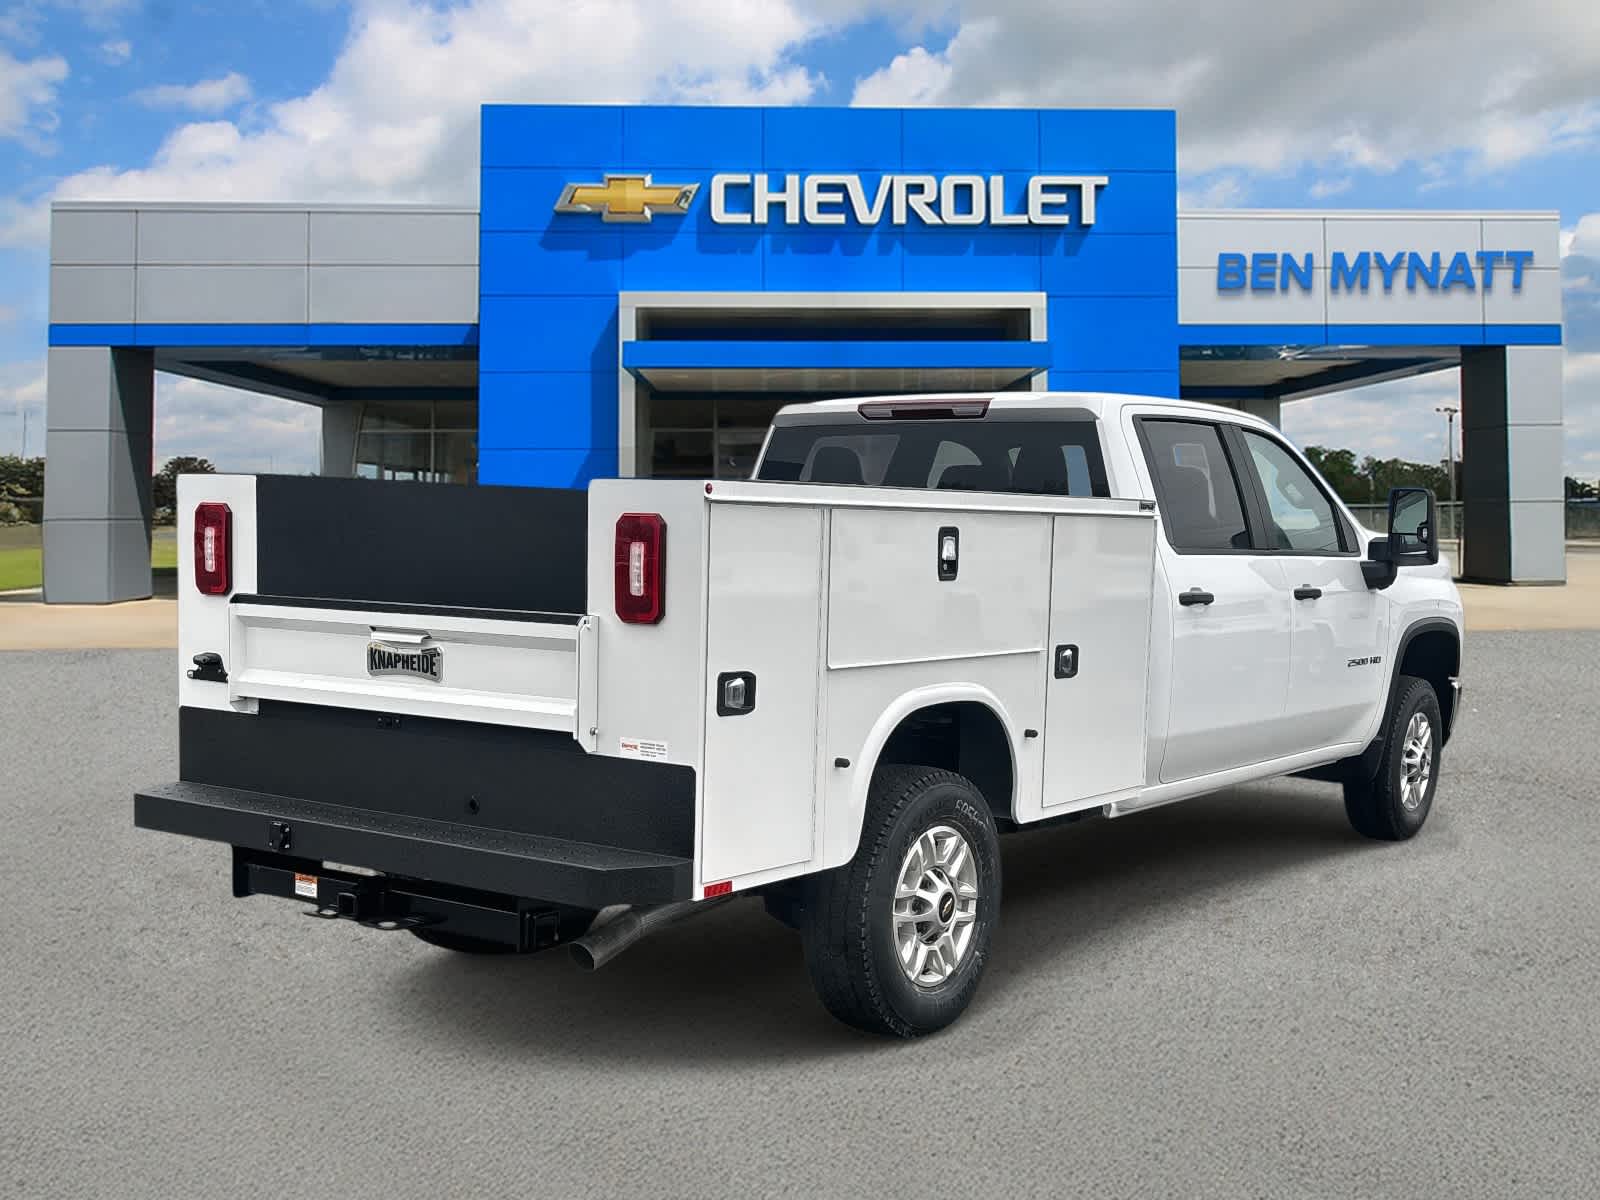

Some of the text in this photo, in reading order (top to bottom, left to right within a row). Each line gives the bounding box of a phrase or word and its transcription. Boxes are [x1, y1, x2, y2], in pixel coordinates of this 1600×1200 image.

[710, 173, 1109, 225] CHEVROLET
[1217, 250, 1534, 290] BEN MYNATT
[369, 646, 439, 677] KNAPHEIDE
